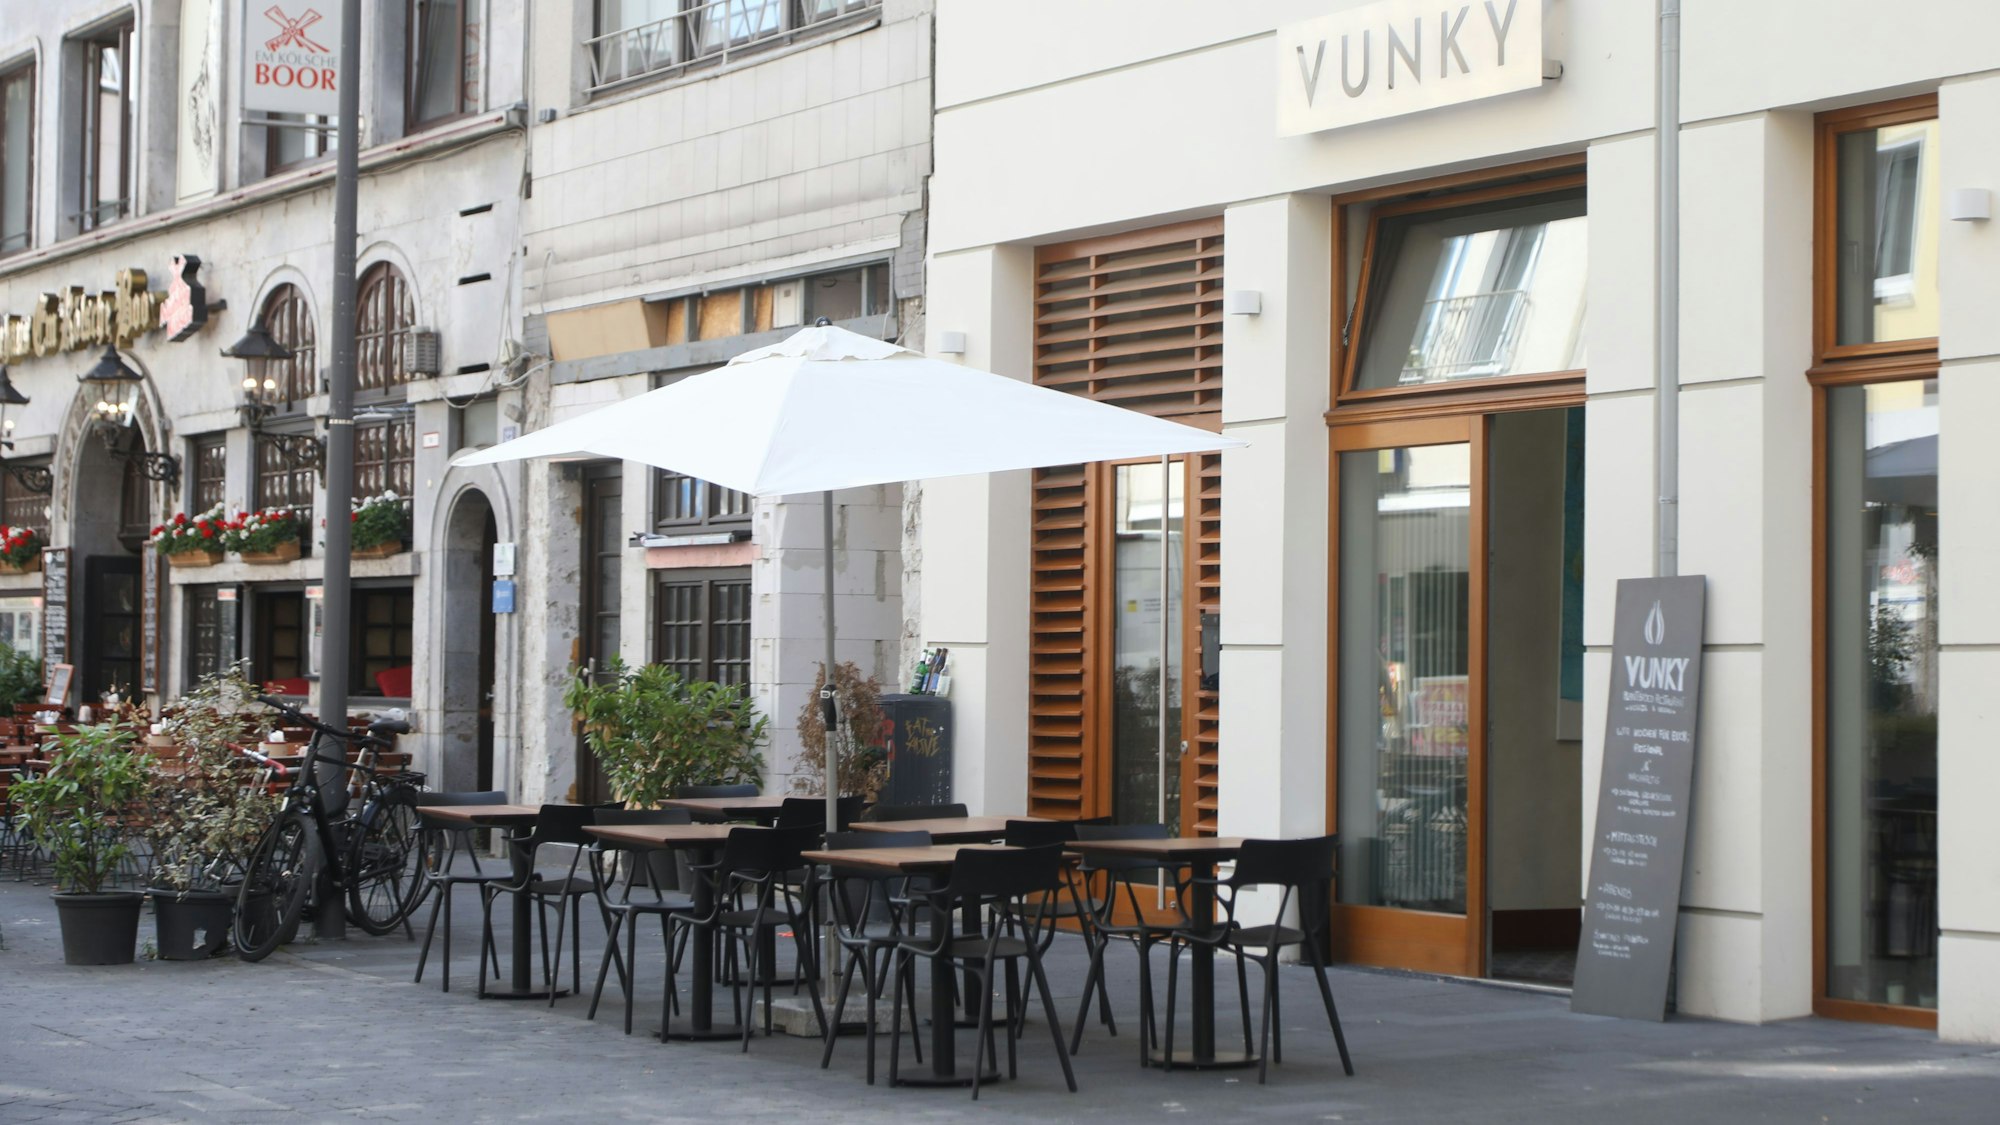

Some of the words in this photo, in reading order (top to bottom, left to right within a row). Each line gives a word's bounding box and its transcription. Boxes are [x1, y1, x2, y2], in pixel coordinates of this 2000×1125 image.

[255, 50, 274, 62] EM
[278, 51, 337, 68] KÖLSCHE
[1296, 0, 1517, 108] VUNKY
[256, 63, 336, 91] BOOR
[1624, 655, 1690, 692] VUNKY
